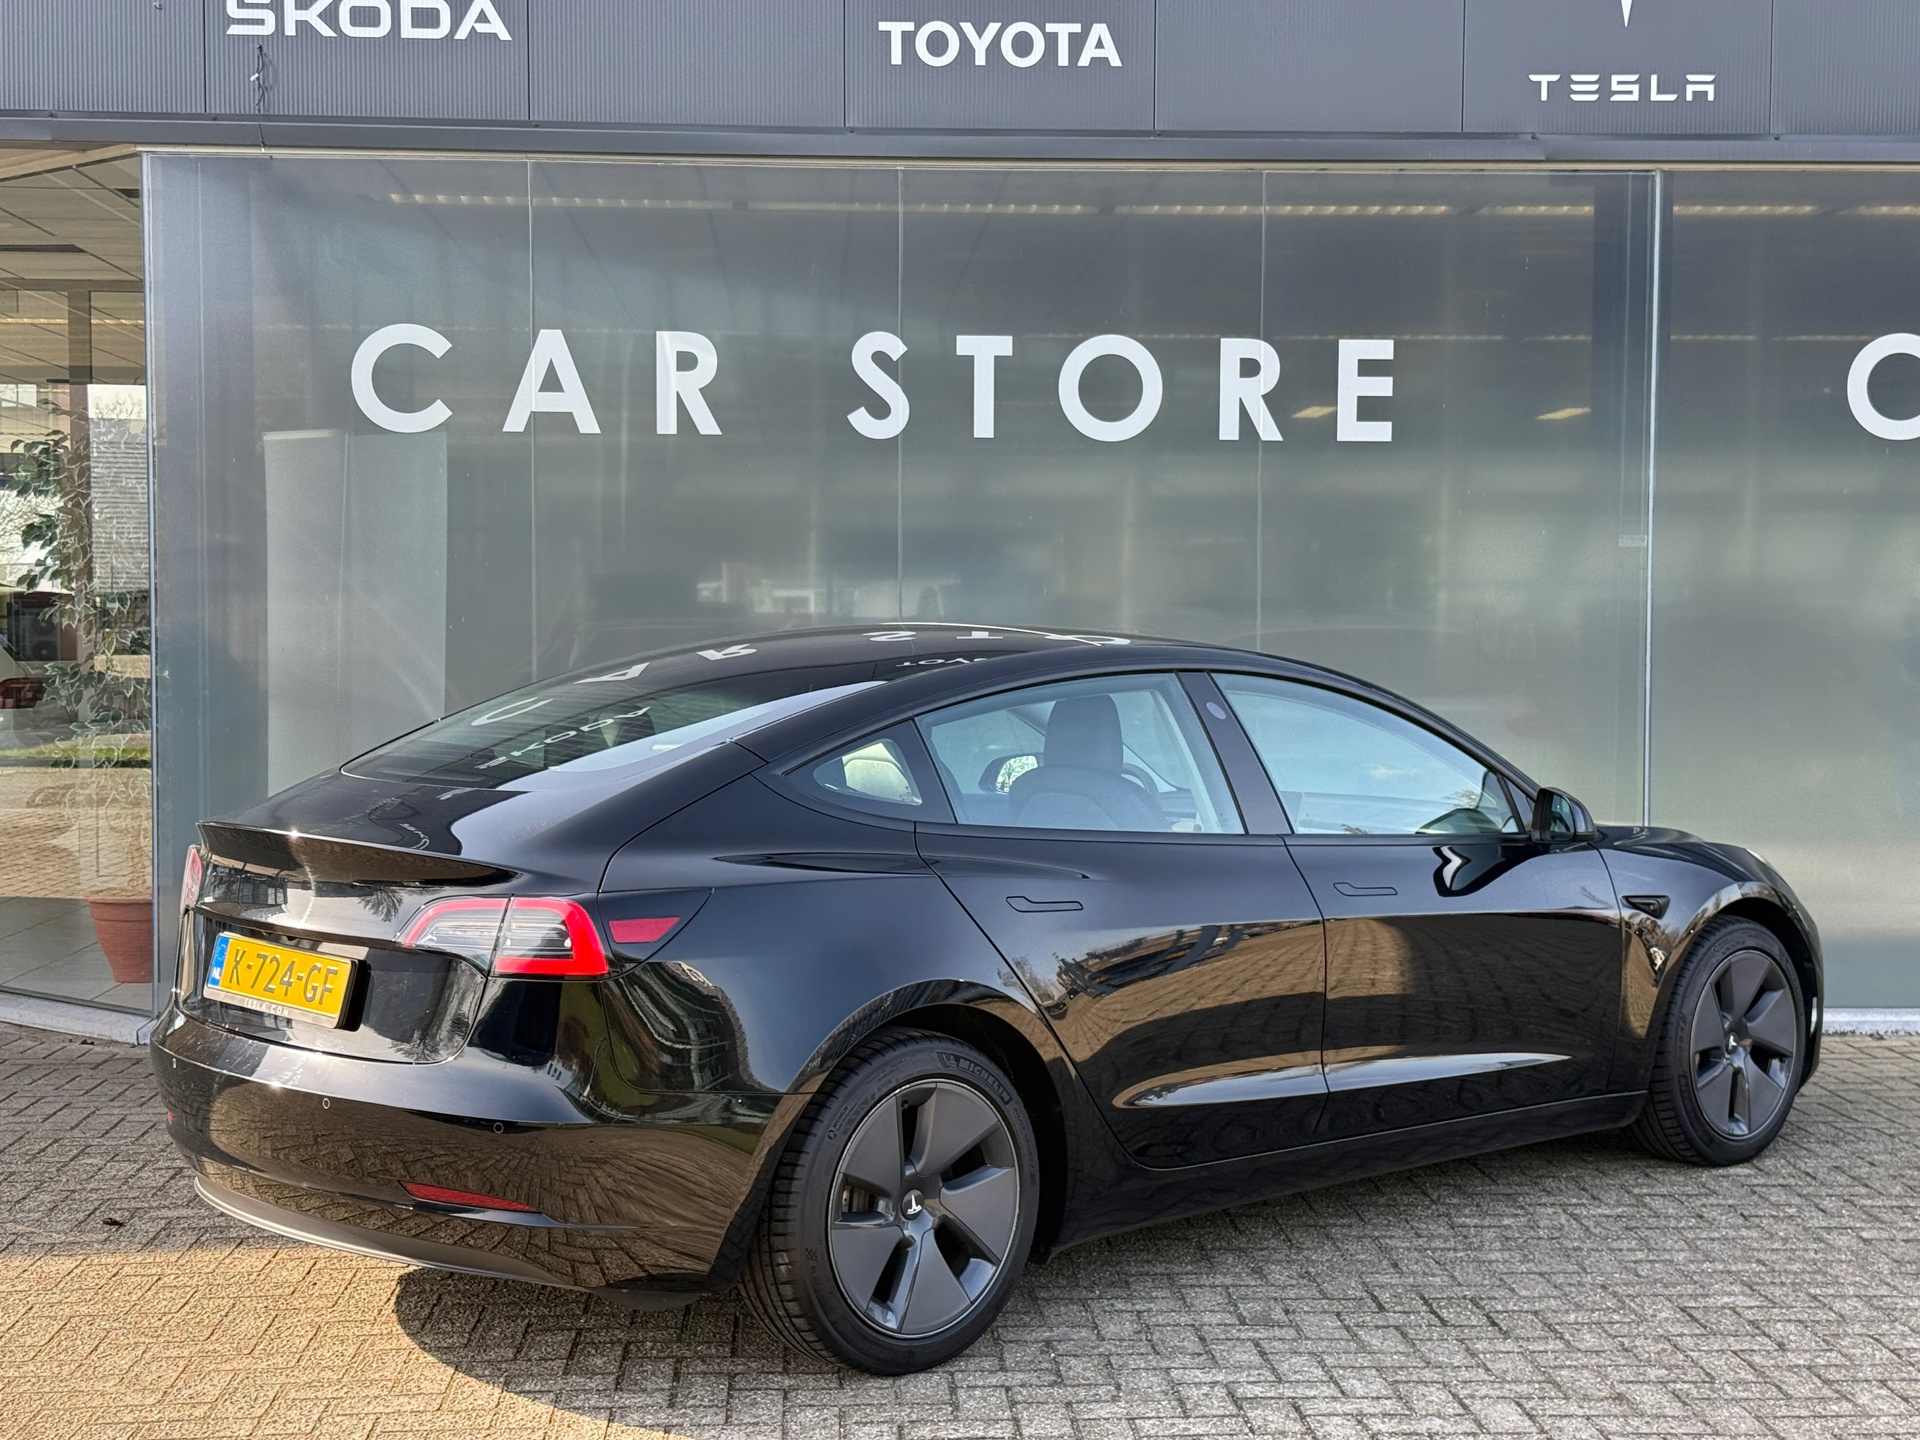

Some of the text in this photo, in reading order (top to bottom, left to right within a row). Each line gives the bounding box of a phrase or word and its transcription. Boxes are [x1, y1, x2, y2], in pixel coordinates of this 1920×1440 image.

[878, 20, 1123, 68] TOYOTA
[1528, 74, 1716, 102] TESLA
[350, 323, 1395, 443] CAR STORE
[211, 966, 222, 980] NL
[229, 946, 339, 1006] K-724-GF
[244, 997, 290, 1017] TESLA.COM
[957, 1057, 1012, 1103] MICHELIN
